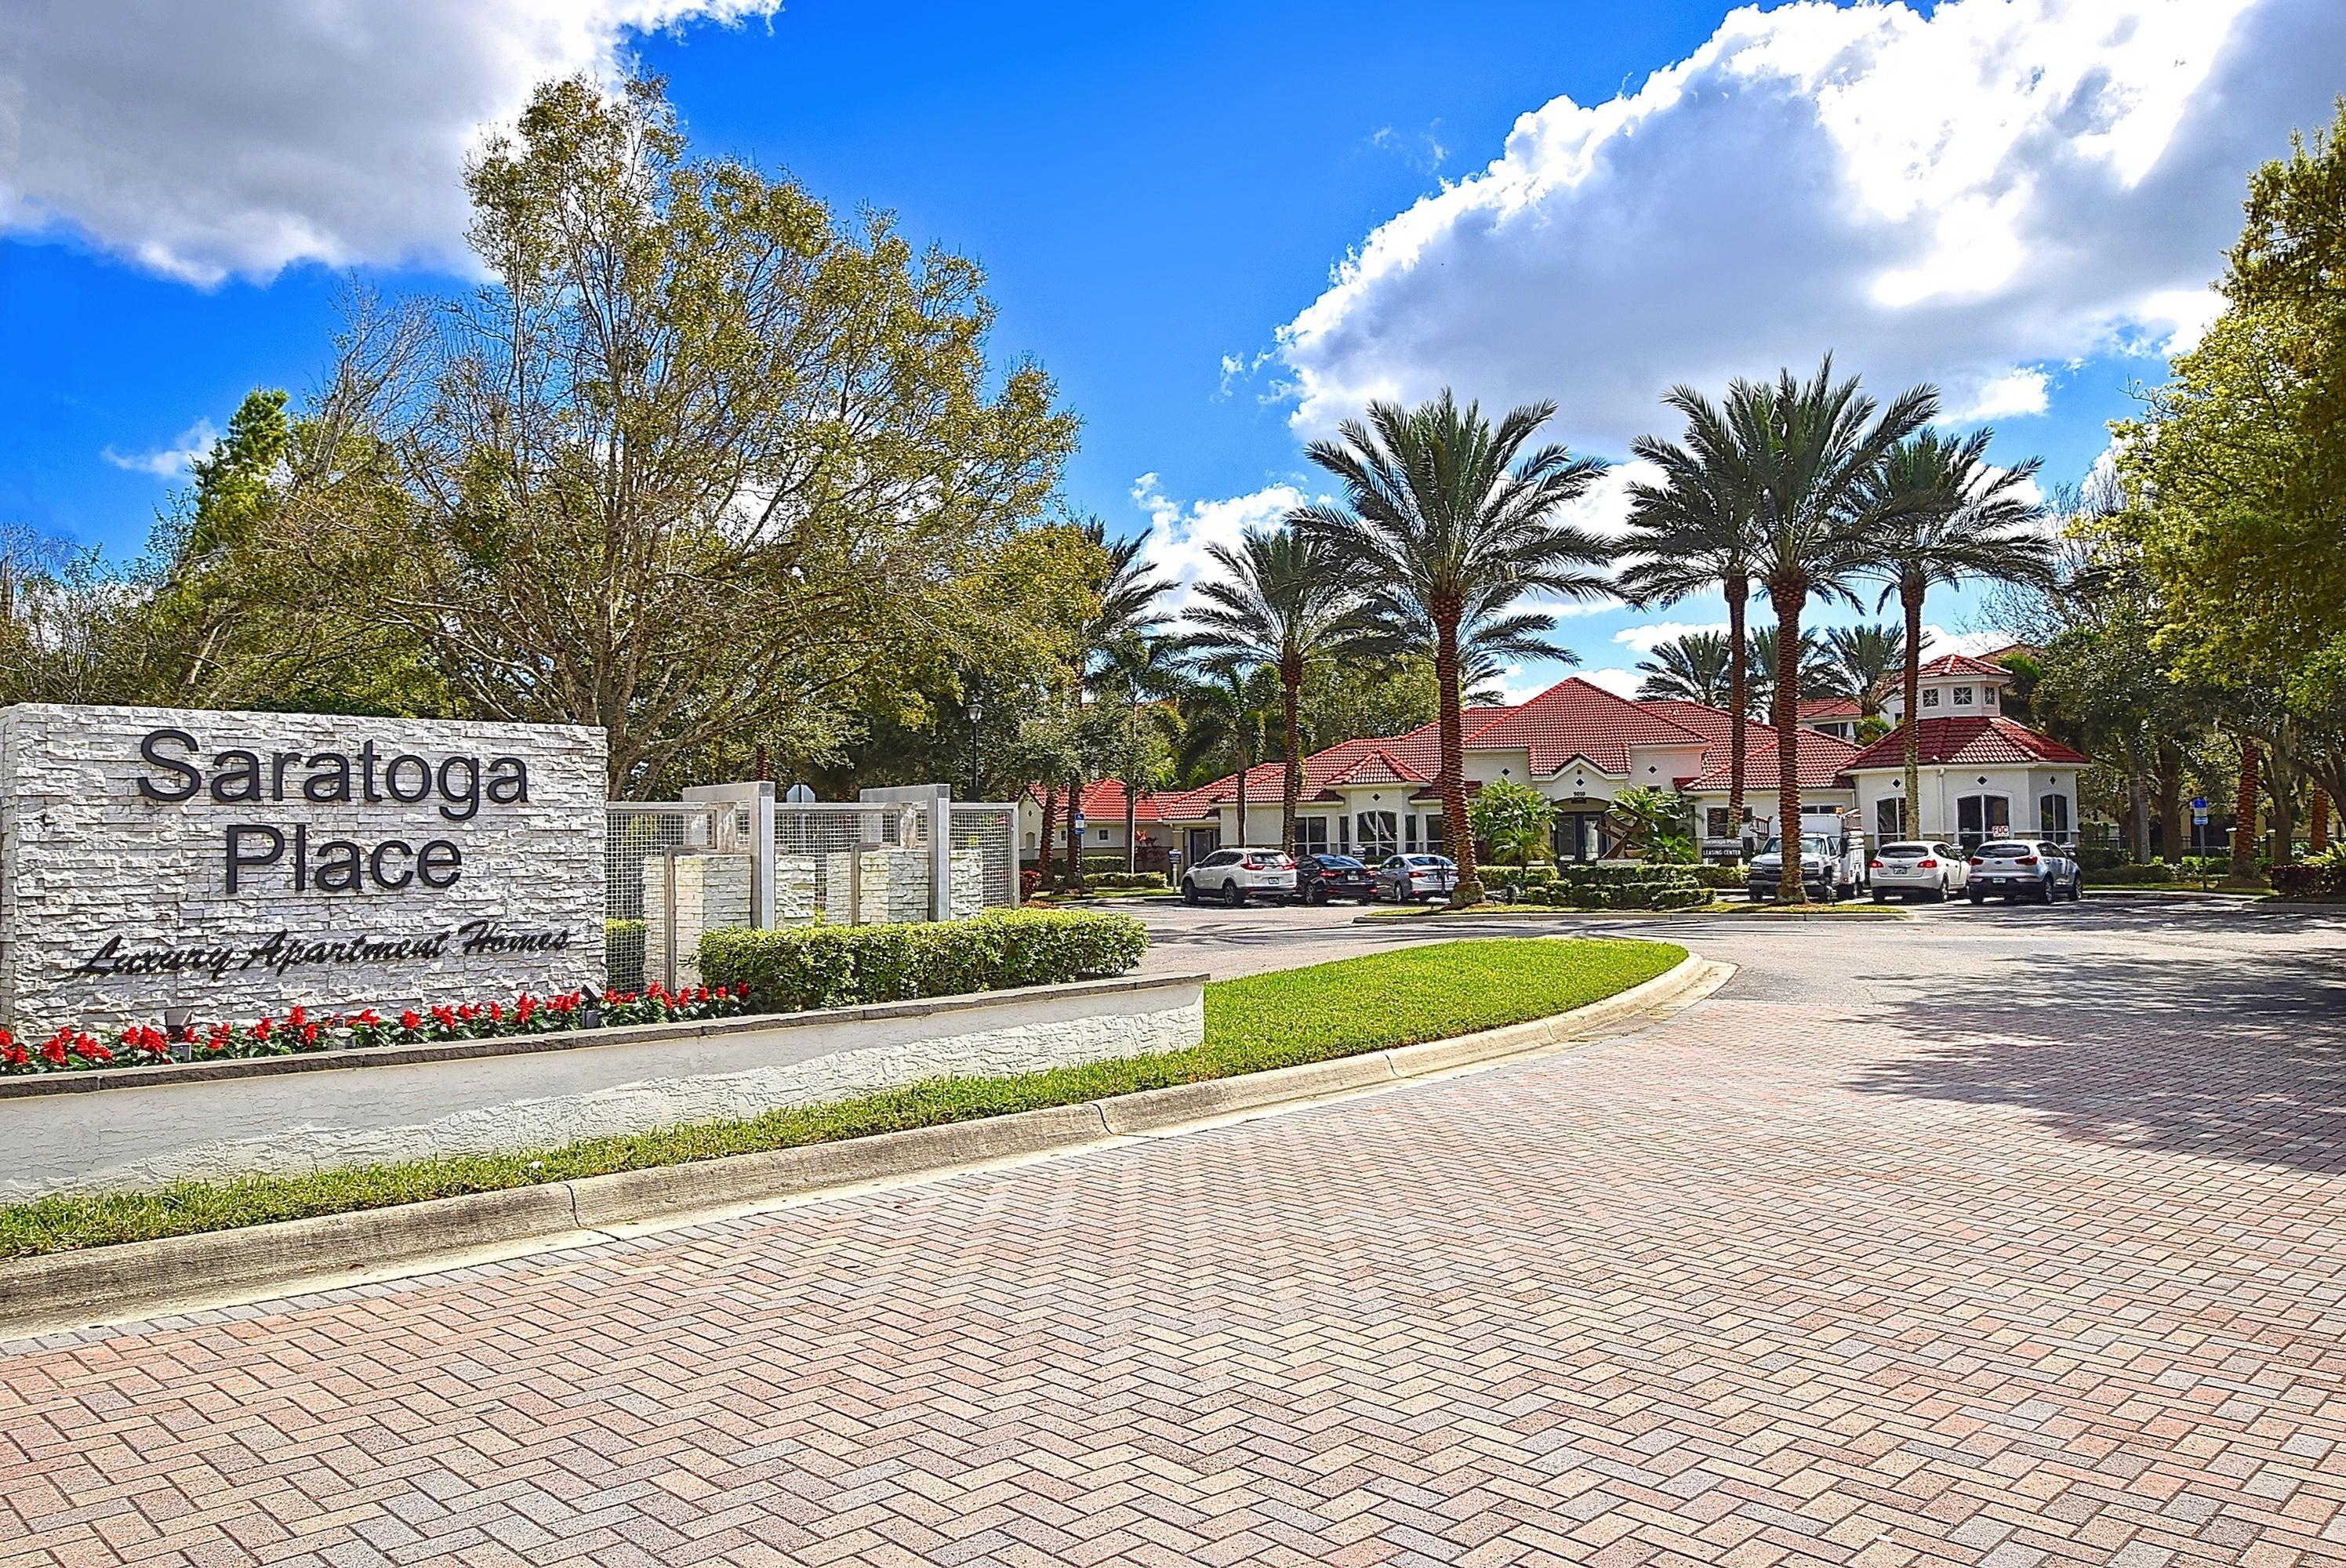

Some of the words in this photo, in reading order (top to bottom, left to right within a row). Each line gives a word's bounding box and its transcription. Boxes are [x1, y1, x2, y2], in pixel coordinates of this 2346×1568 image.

[136, 728, 530, 821] Saratoga
[225, 824, 463, 895] Place
[72, 934, 236, 982] Luxury
[238, 927, 451, 978] Apartment
[457, 919, 571, 953] Homes
